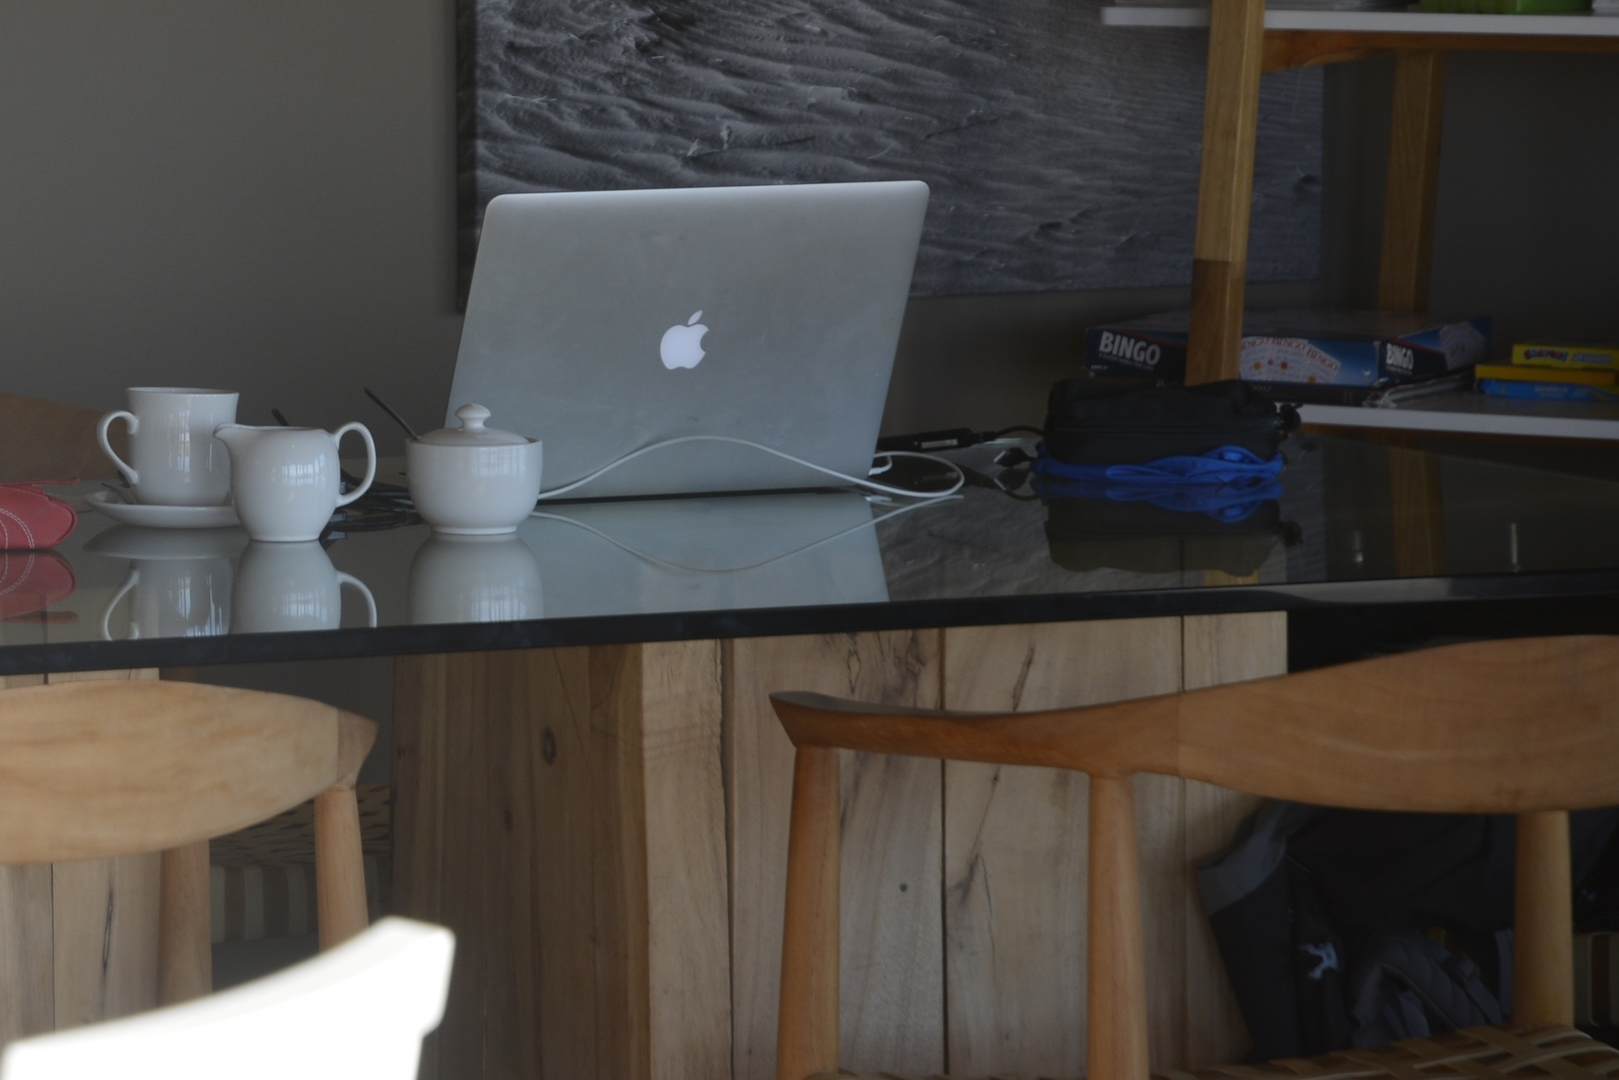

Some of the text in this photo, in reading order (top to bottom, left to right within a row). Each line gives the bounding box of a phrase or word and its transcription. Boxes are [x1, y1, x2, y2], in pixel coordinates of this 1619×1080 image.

[1099, 330, 1161, 366] BINGO
[1306, 345, 1338, 371] BINGO
[1386, 342, 1414, 371] BINGO
